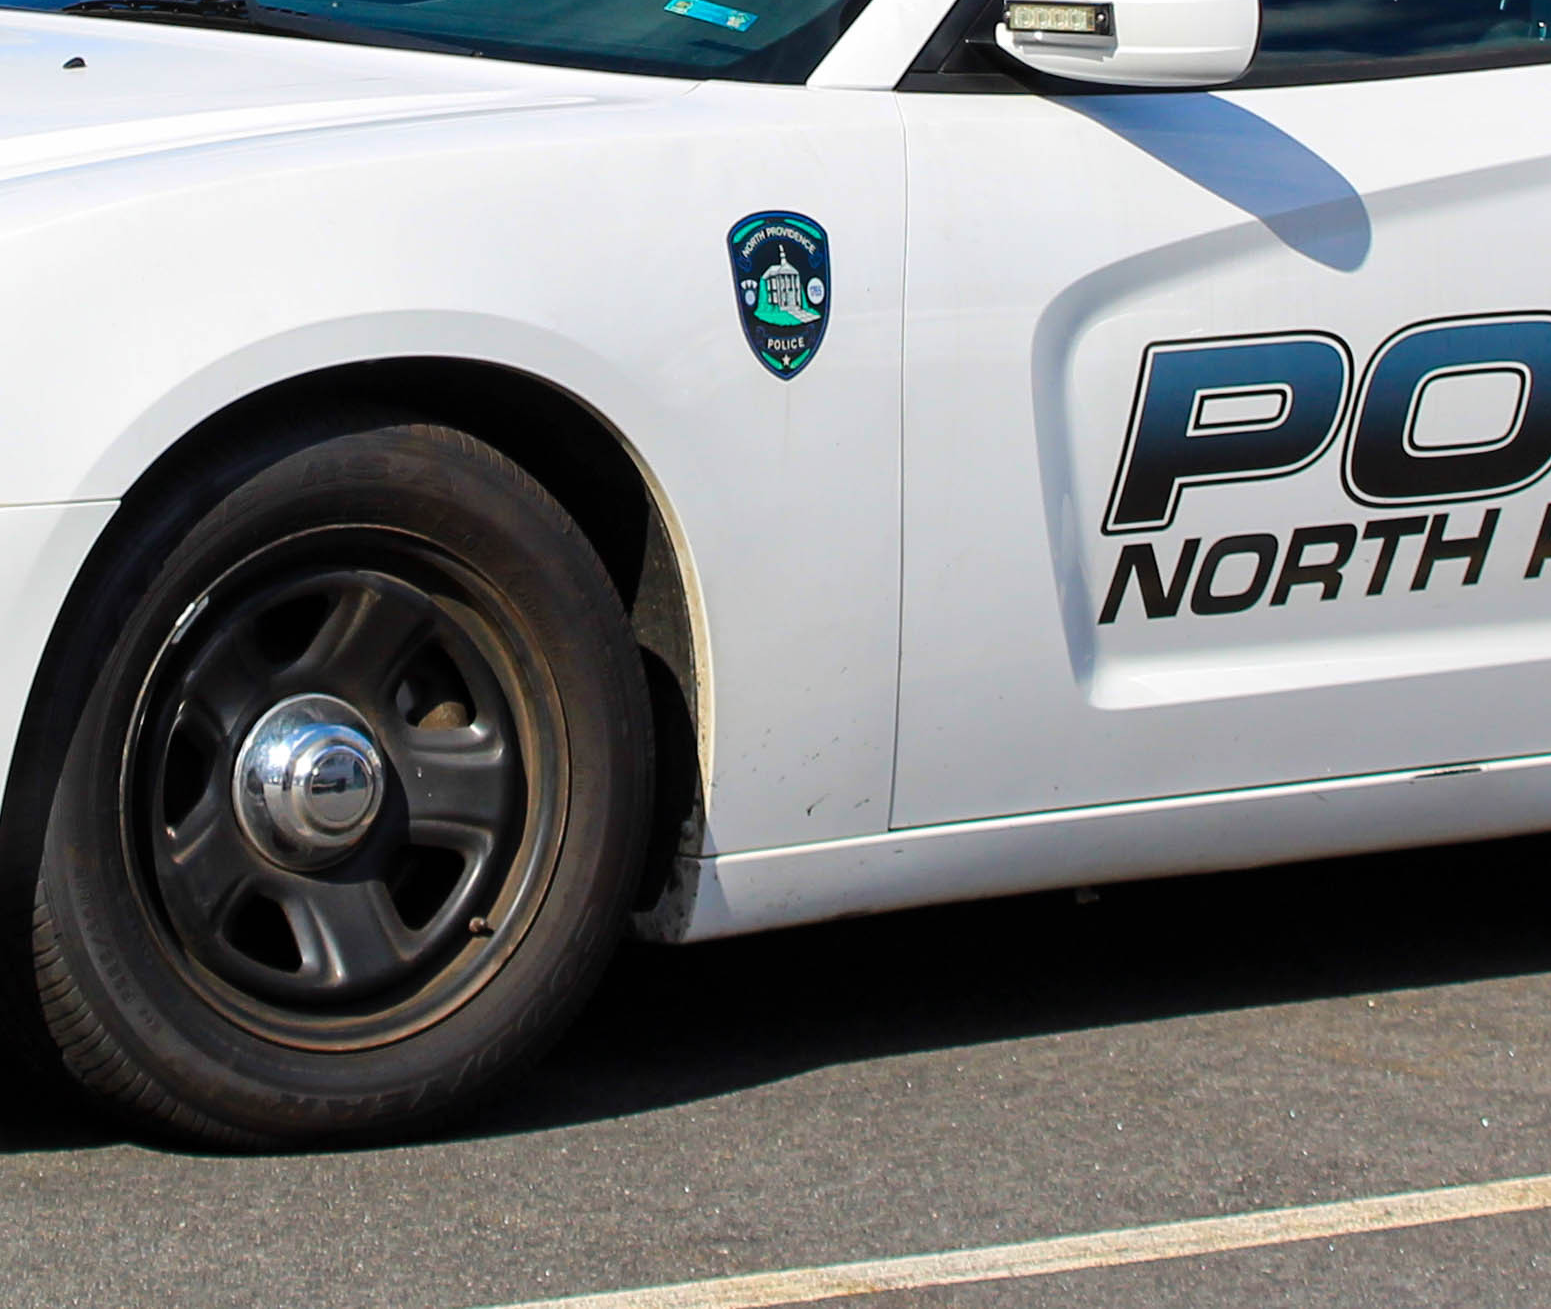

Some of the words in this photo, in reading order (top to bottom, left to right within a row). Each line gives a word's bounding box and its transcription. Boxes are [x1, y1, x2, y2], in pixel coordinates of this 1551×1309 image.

[742, 232, 766, 258] NORTH
[766, 226, 817, 255] PROVIDENCE
[768, 337, 805, 351] POLICE
[1098, 508, 1502, 625] NORTH
